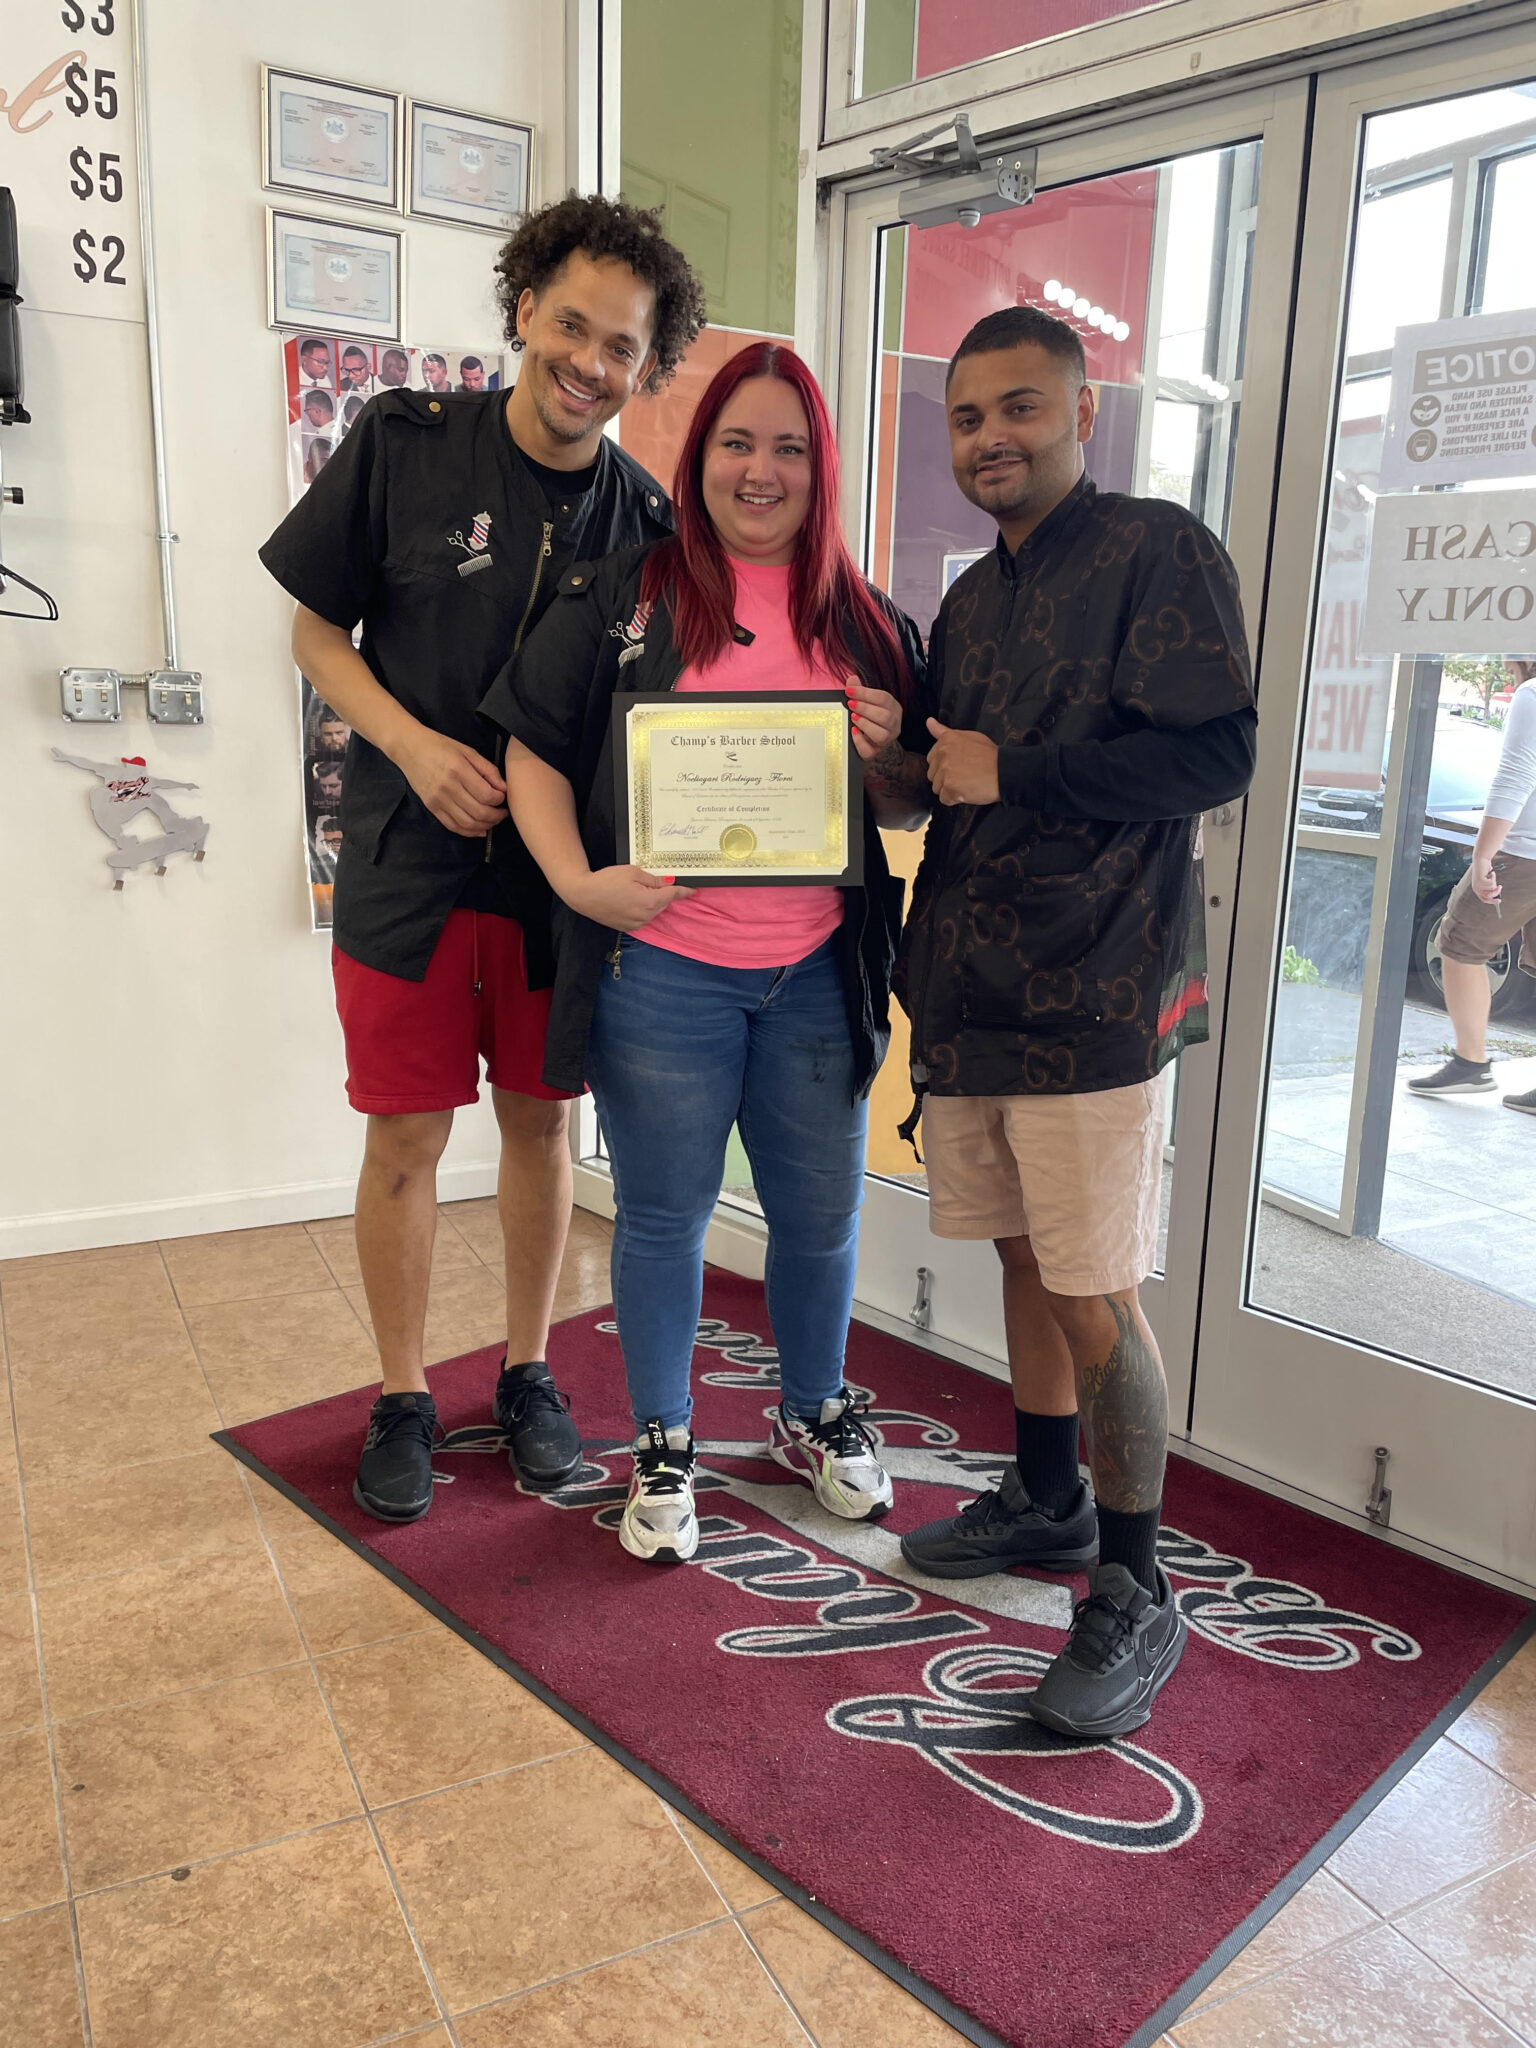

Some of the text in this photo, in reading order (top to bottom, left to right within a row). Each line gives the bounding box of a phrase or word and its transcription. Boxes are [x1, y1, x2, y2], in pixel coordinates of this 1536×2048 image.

[61, 0, 115, 36] $3
[64, 61, 118, 120] $5
[69, 145, 123, 203] $5
[72, 228, 127, 285] $2
[670, 735, 796, 747] Champ's Barber School
[696, 805, 727, 813] Certificate
[735, 805, 770, 814] Completion
